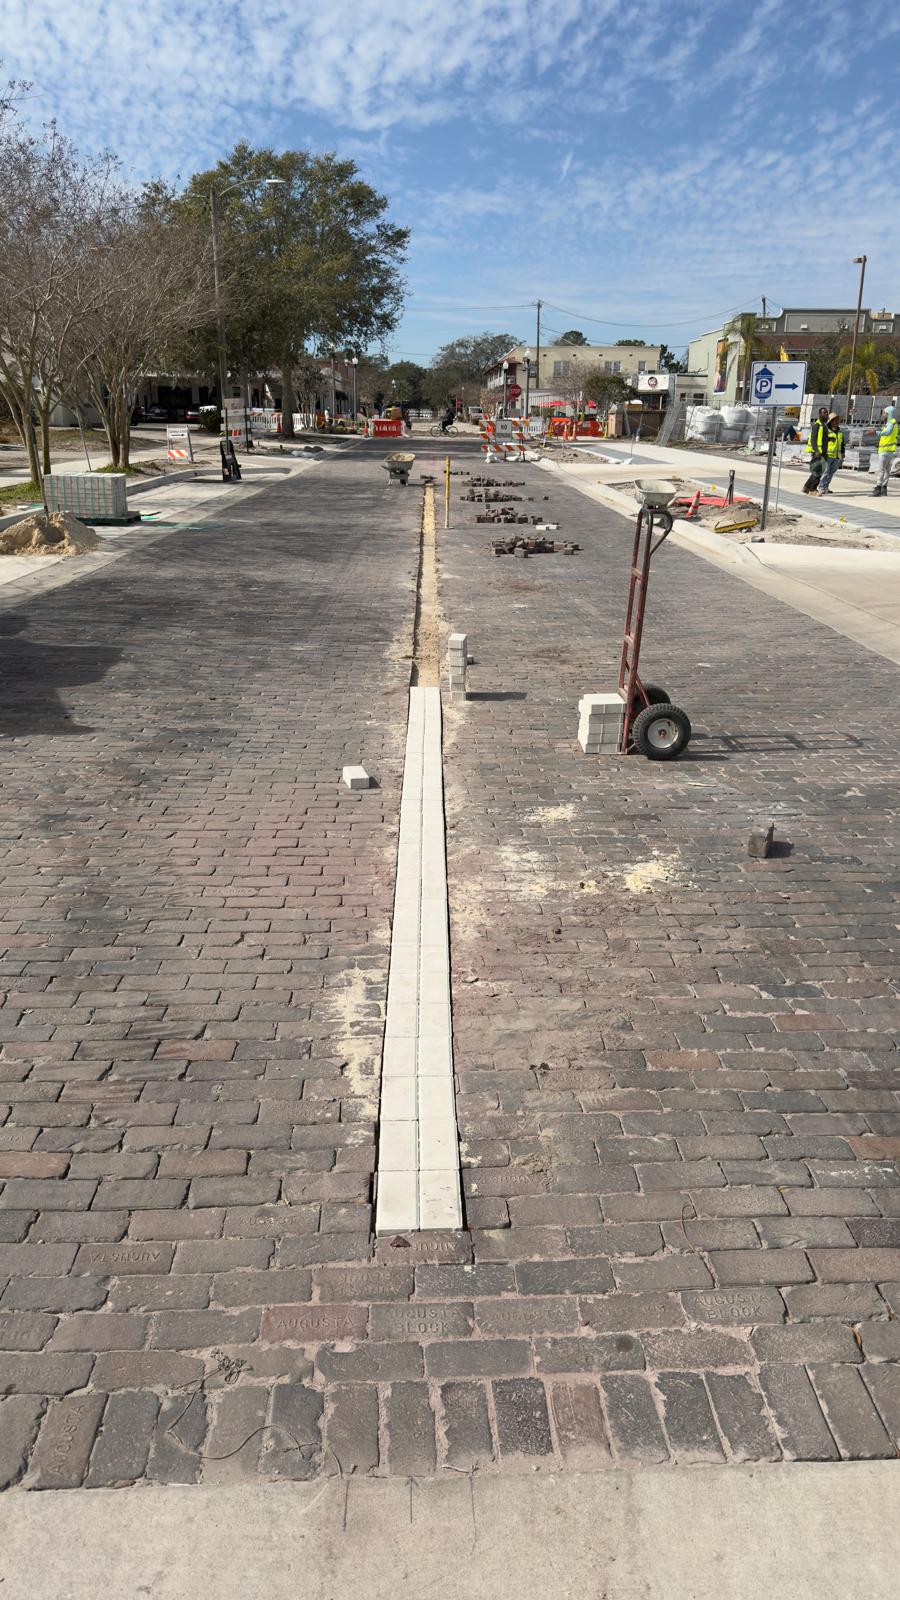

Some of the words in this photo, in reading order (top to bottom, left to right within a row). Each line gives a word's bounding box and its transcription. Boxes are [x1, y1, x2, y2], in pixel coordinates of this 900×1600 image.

[760, 380, 769, 391] P
[89, 1251, 160, 1263] AUGUSTA
[694, 1293, 770, 1305] AUGUSTA
[276, 1316, 354, 1329] AUGUSTA
[49, 1404, 85, 1475] AUGUSTA
